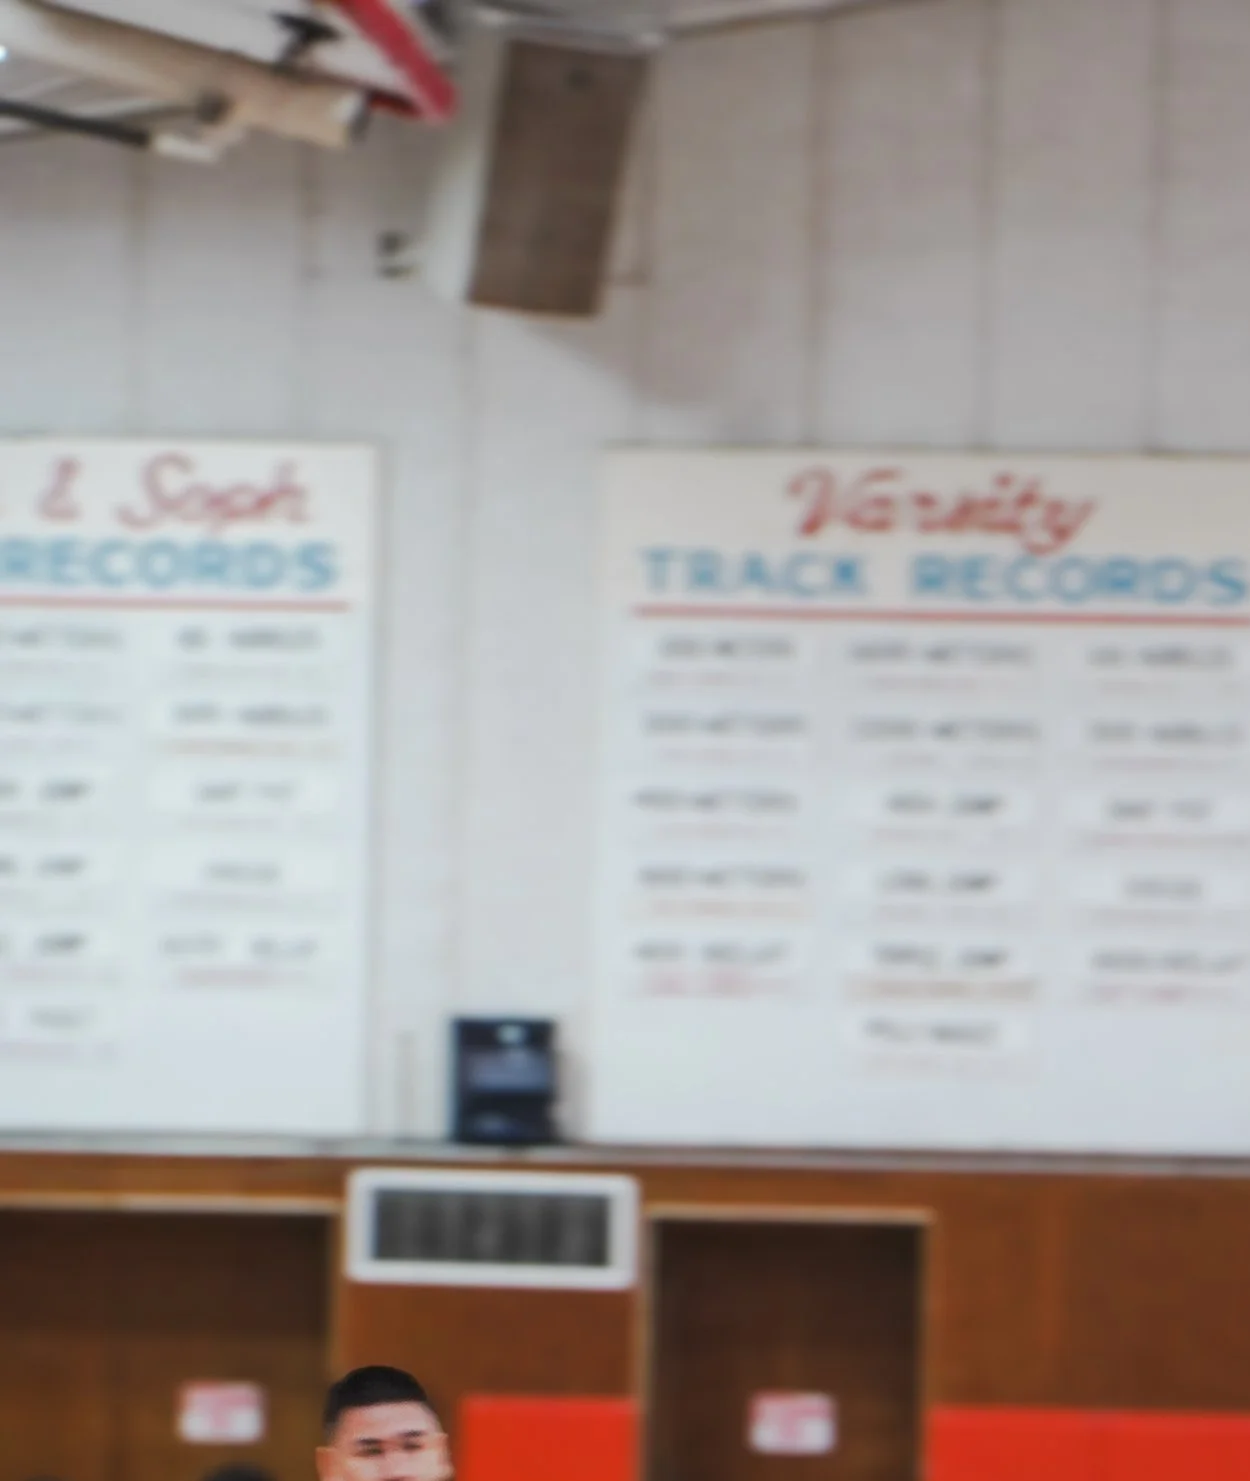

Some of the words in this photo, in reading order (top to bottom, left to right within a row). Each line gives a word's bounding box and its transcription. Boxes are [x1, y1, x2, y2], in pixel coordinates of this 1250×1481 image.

[114, 451, 312, 537] Soph
[785, 465, 1097, 557] Varsity
[0, 536, 342, 592] RECORDS
[641, 547, 867, 599] TRACK
